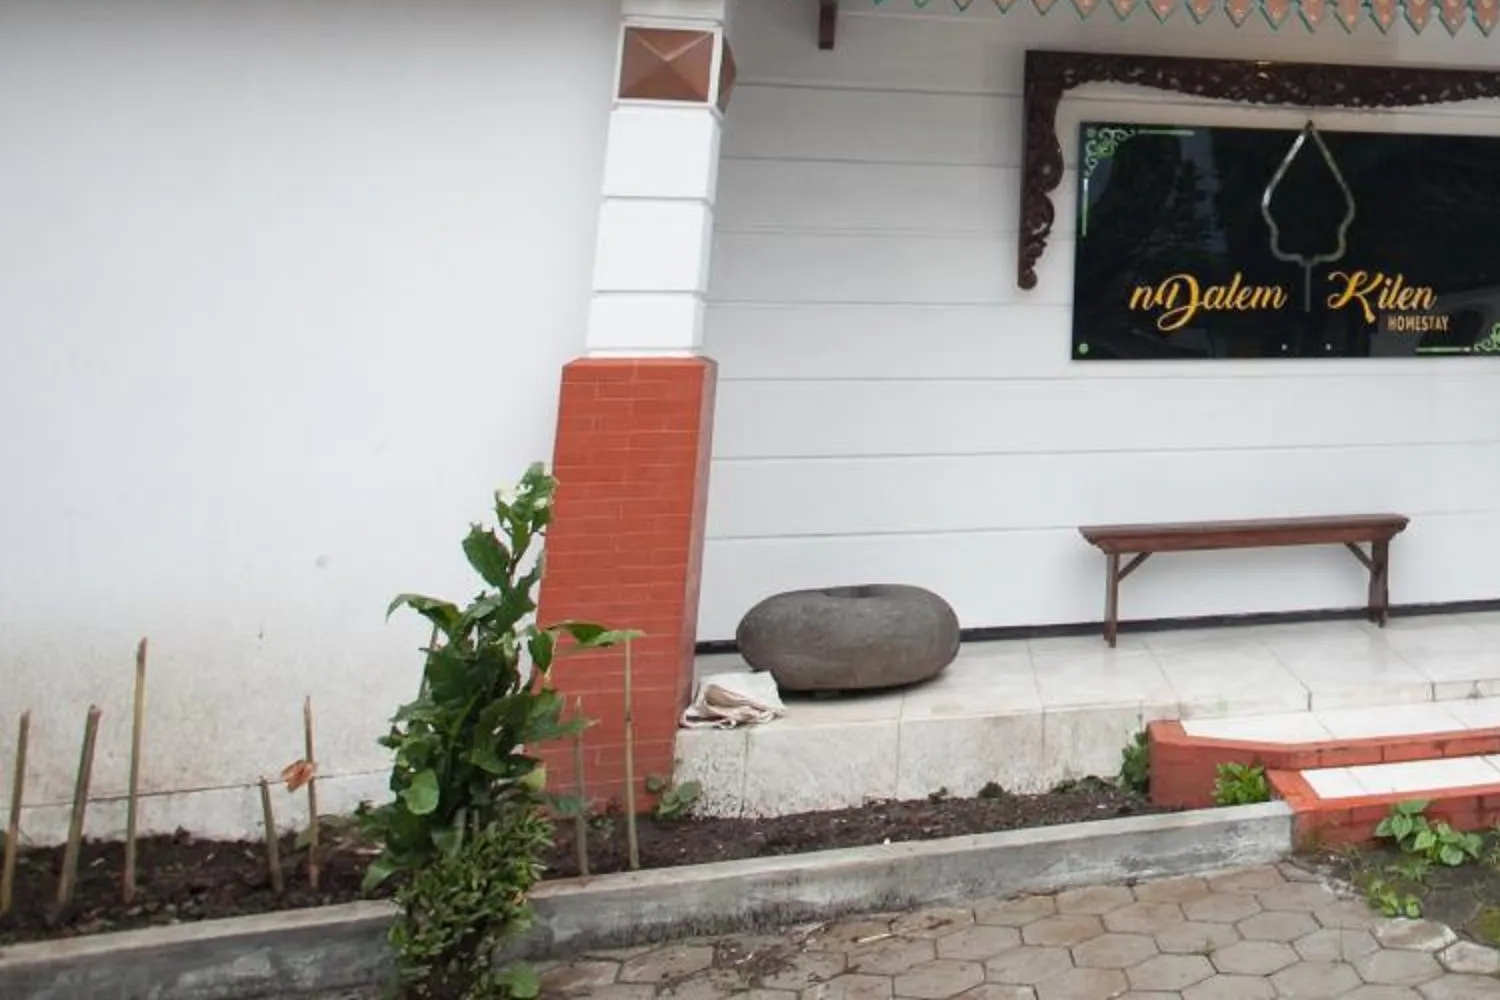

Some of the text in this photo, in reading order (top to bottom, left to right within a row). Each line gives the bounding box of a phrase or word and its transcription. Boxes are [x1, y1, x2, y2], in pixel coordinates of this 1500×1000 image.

[1128, 270, 1437, 331] nDalem Kilen
[1387, 315, 1449, 332] HOMESTAY
